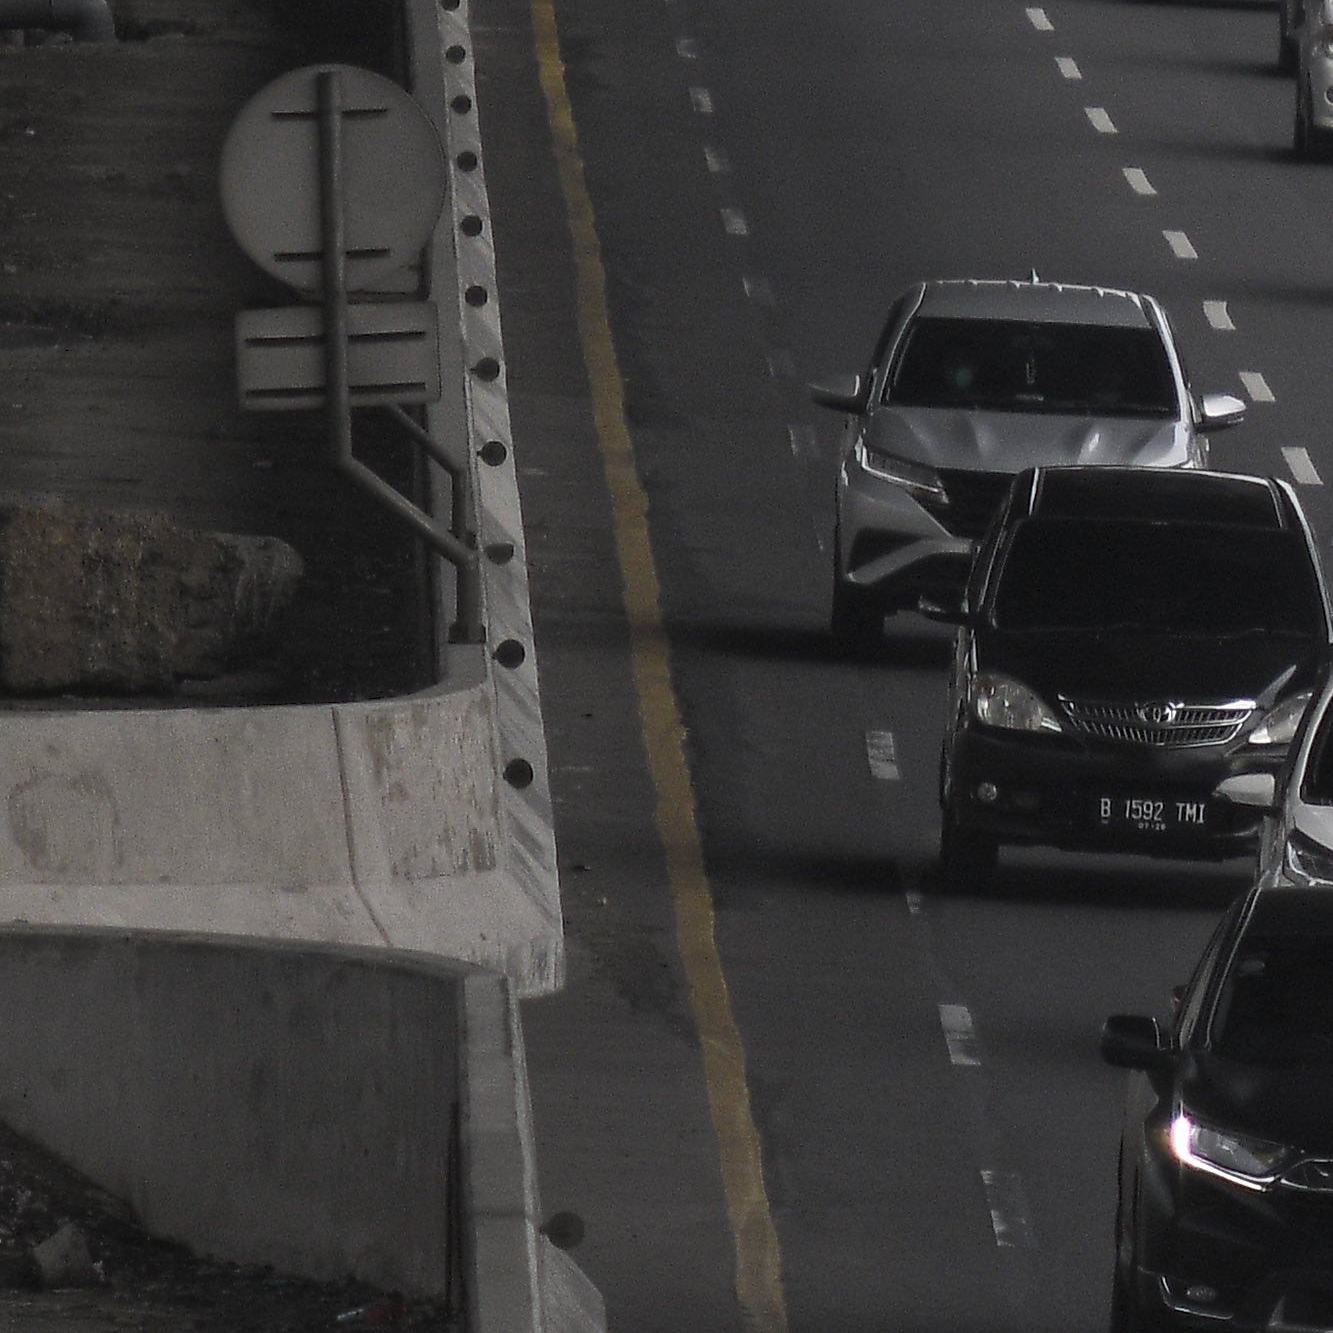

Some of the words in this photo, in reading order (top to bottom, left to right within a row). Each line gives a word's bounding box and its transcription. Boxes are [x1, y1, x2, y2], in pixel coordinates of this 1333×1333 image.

[1100, 797, 1111, 818] B
[1125, 799, 1164, 822] 1592
[1176, 802, 1206, 824] TMI
